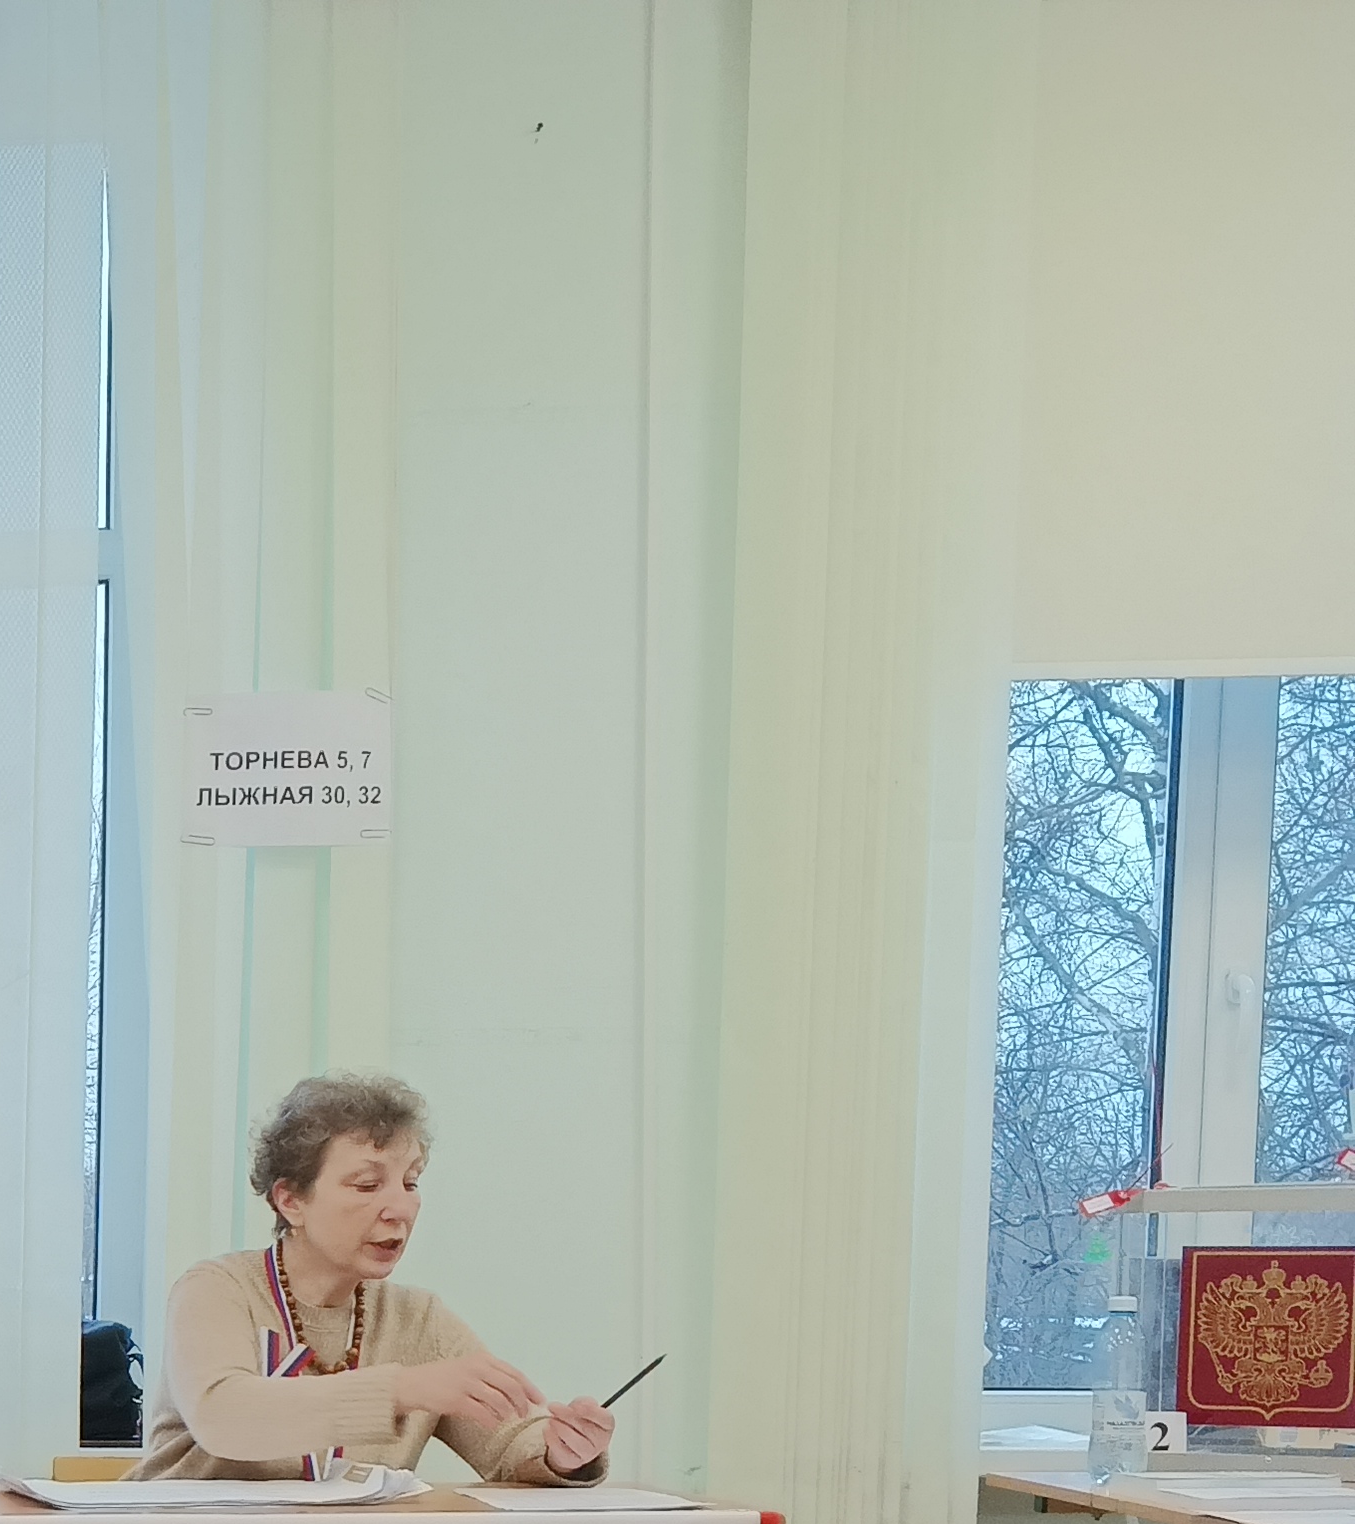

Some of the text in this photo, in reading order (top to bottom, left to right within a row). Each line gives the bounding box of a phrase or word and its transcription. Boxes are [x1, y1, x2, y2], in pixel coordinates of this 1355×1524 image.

[209, 750, 372, 772] ТОРНЕВА 5, 7
[197, 786, 382, 807] ЛЫЖНАЯ 30, 32
[1150, 1422, 1170, 1451] 2
